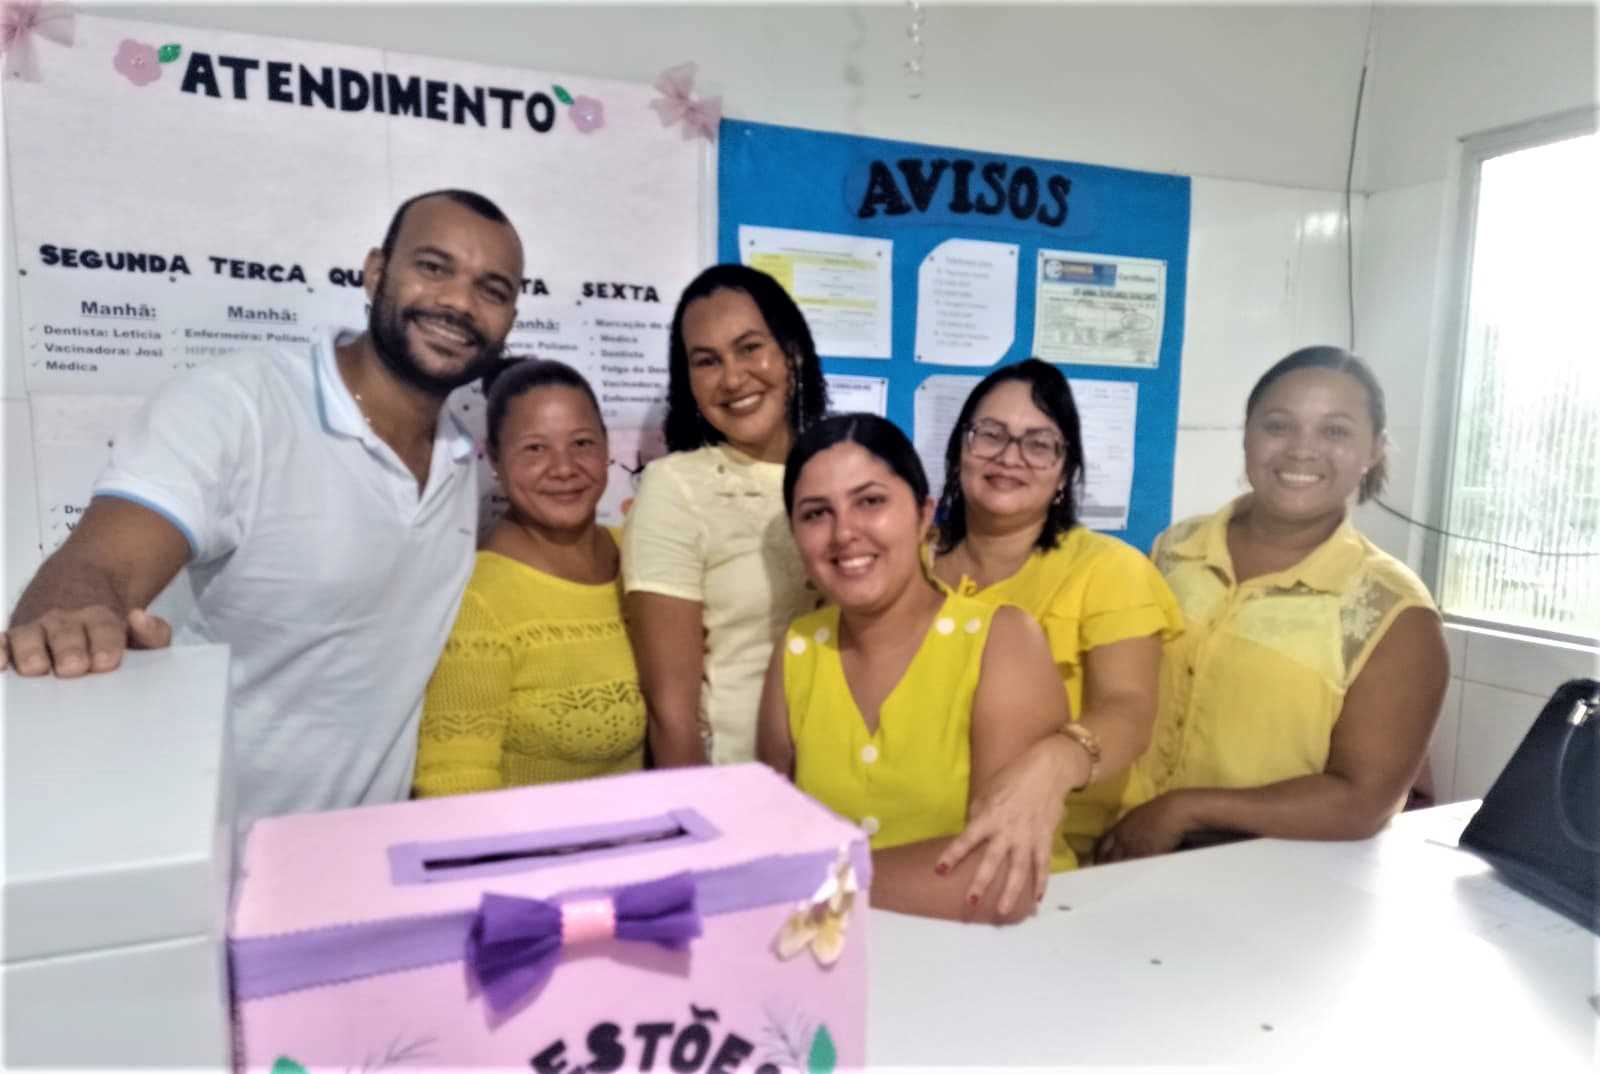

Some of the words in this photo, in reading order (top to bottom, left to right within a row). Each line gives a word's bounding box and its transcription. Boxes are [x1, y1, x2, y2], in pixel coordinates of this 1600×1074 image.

[180, 51, 557, 133] ATENDIMENTO
[857, 158, 1073, 227] AVISOS
[39, 244, 191, 275] SEGUNDA
[582, 281, 660, 303] SEXTA
[81, 301, 157, 318] Manhã:
[227, 305, 298, 322] Manhã:
[44, 325, 109, 337] Dentista:
[514, 317, 561, 333] anhã:
[44, 343, 131, 356] Vacinadora:
[529, 1002, 783, 1074] ESTÕE
